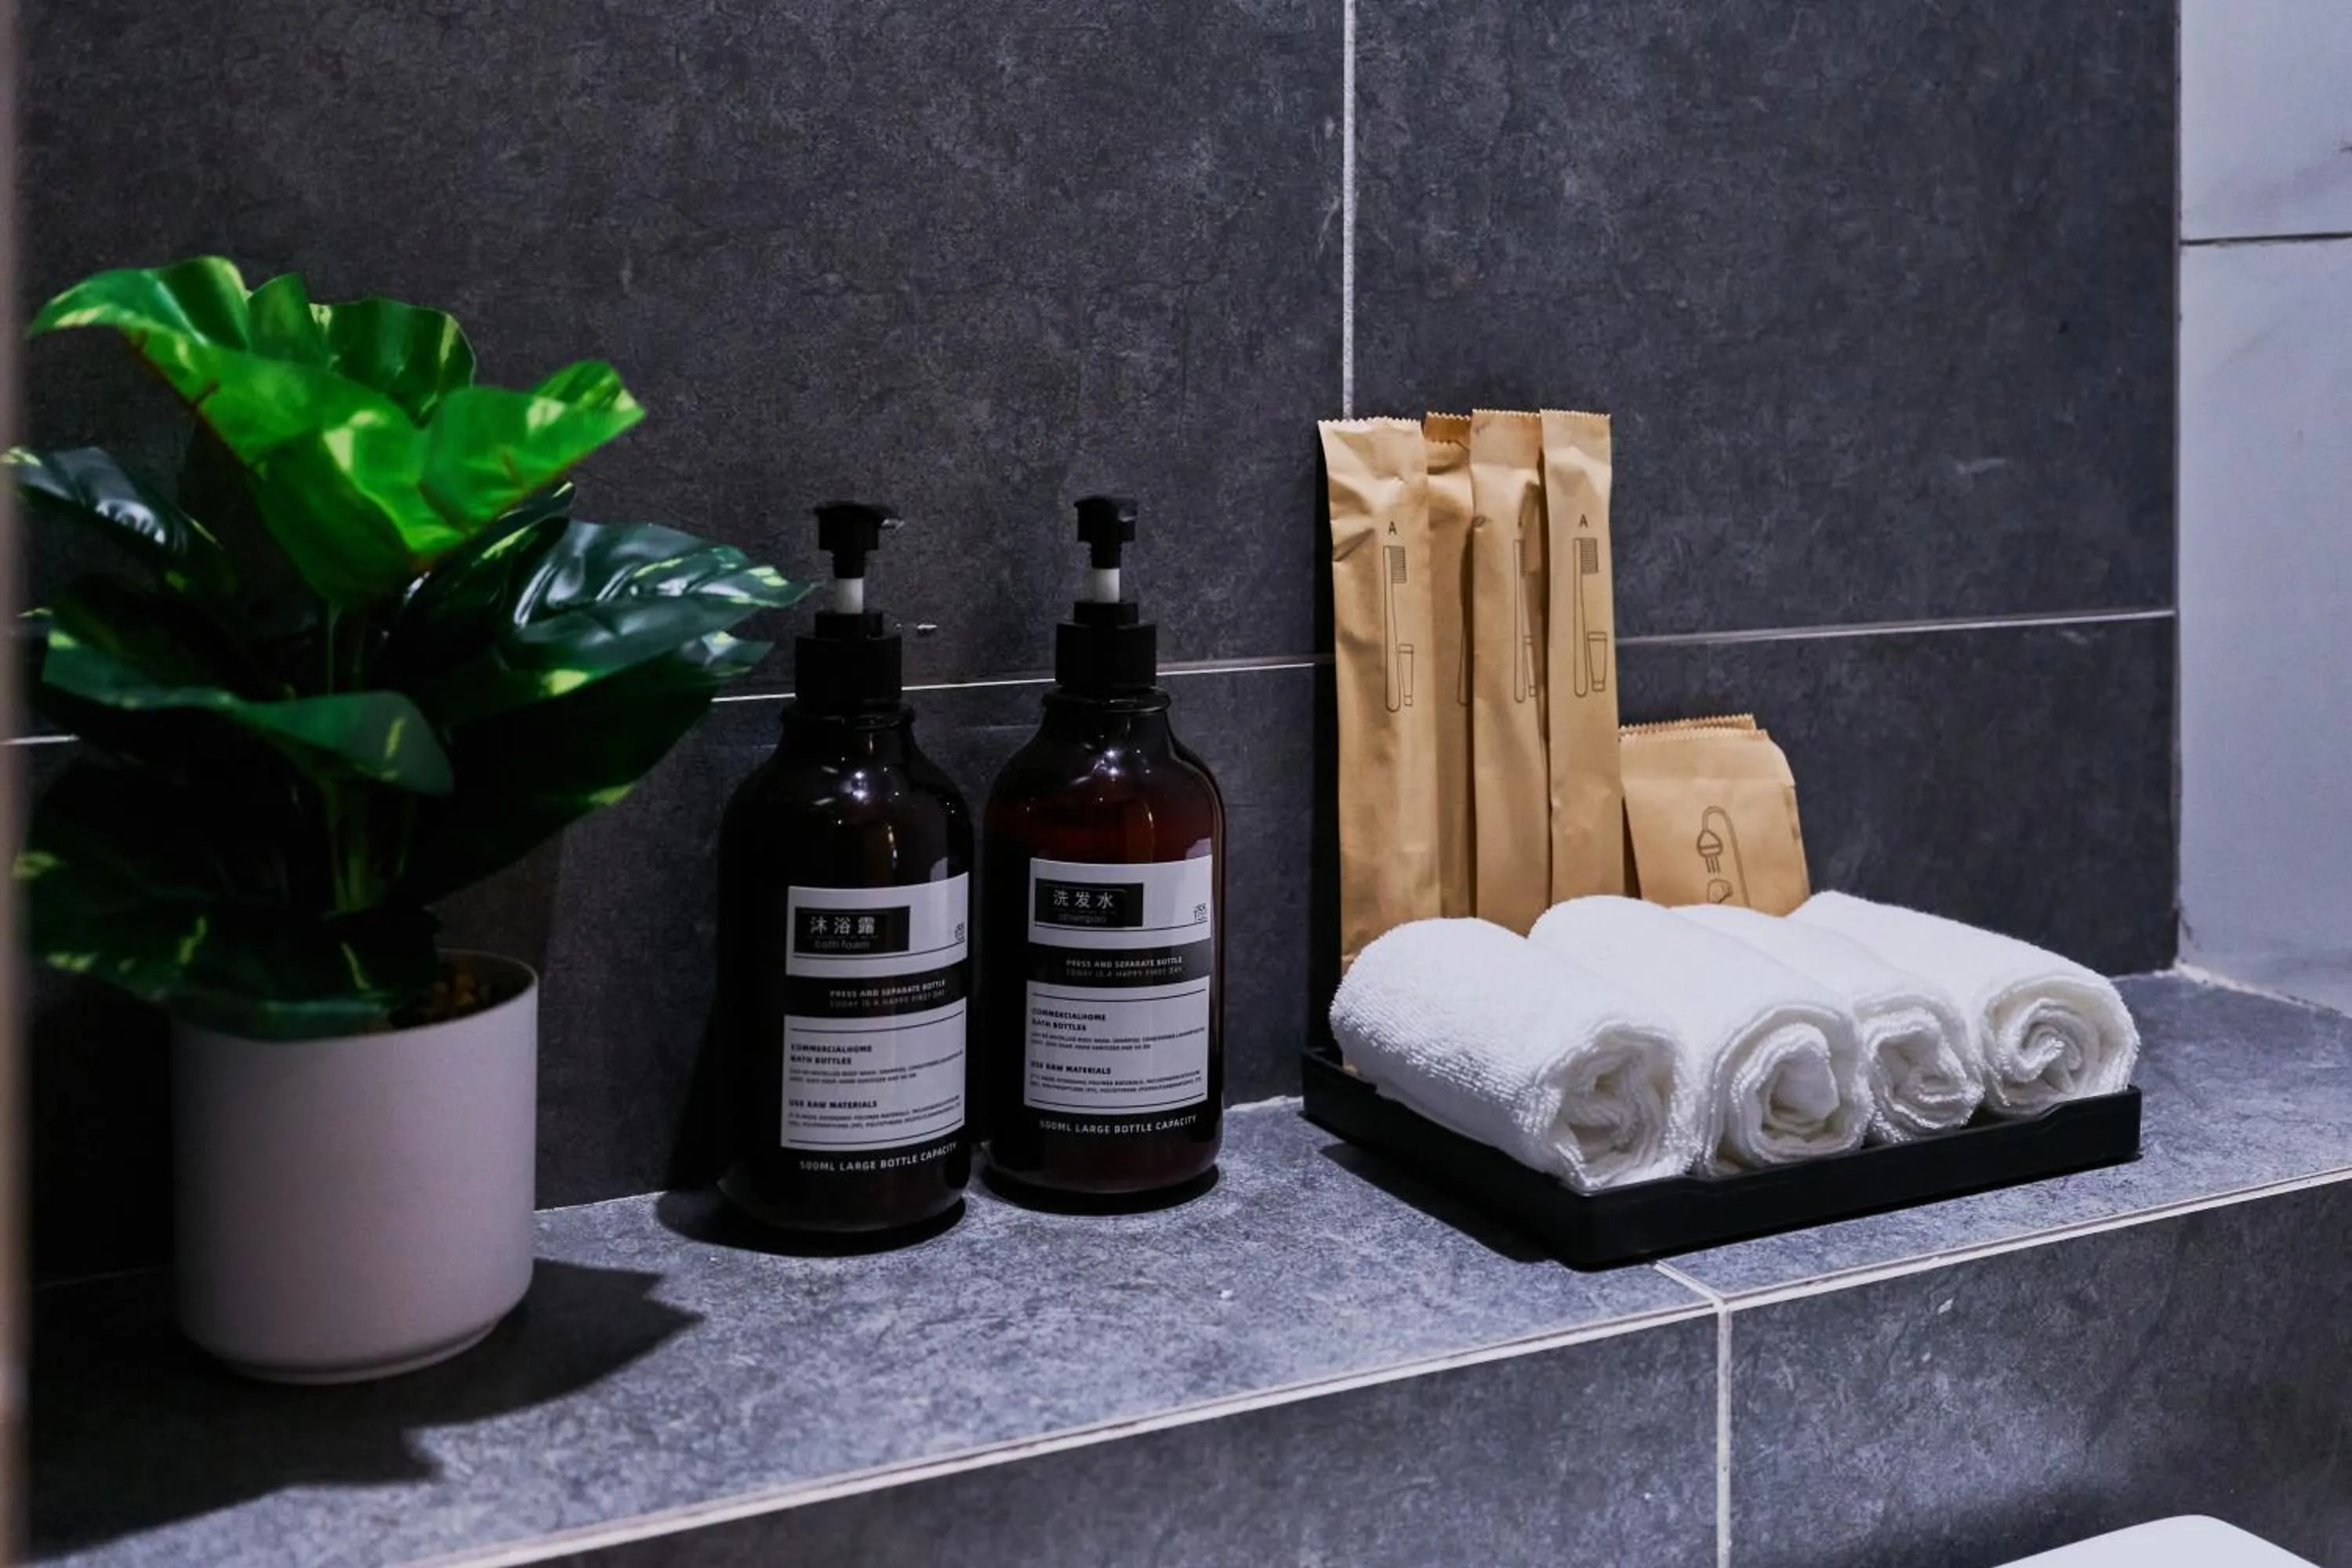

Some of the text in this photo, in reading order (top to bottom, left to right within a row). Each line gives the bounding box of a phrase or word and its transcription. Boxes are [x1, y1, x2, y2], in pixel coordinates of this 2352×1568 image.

[1388, 521, 1397, 535] A
[1580, 514, 1588, 528] A
[1053, 890, 1114, 909] 洗发水
[810, 916, 876, 935] 沐浴露
[1094, 960, 1112, 968] AND
[1066, 1065, 1112, 1075] MATERIALS
[829, 1099, 878, 1109] MATERIALS
[1075, 1121, 1110, 1134] LARGE
[1113, 1122, 1152, 1134] BOTTLE
[1156, 1114, 1197, 1131] CAPACITY
[800, 1142, 957, 1171] 500ML LARGE BOTTLE CAPACITY
